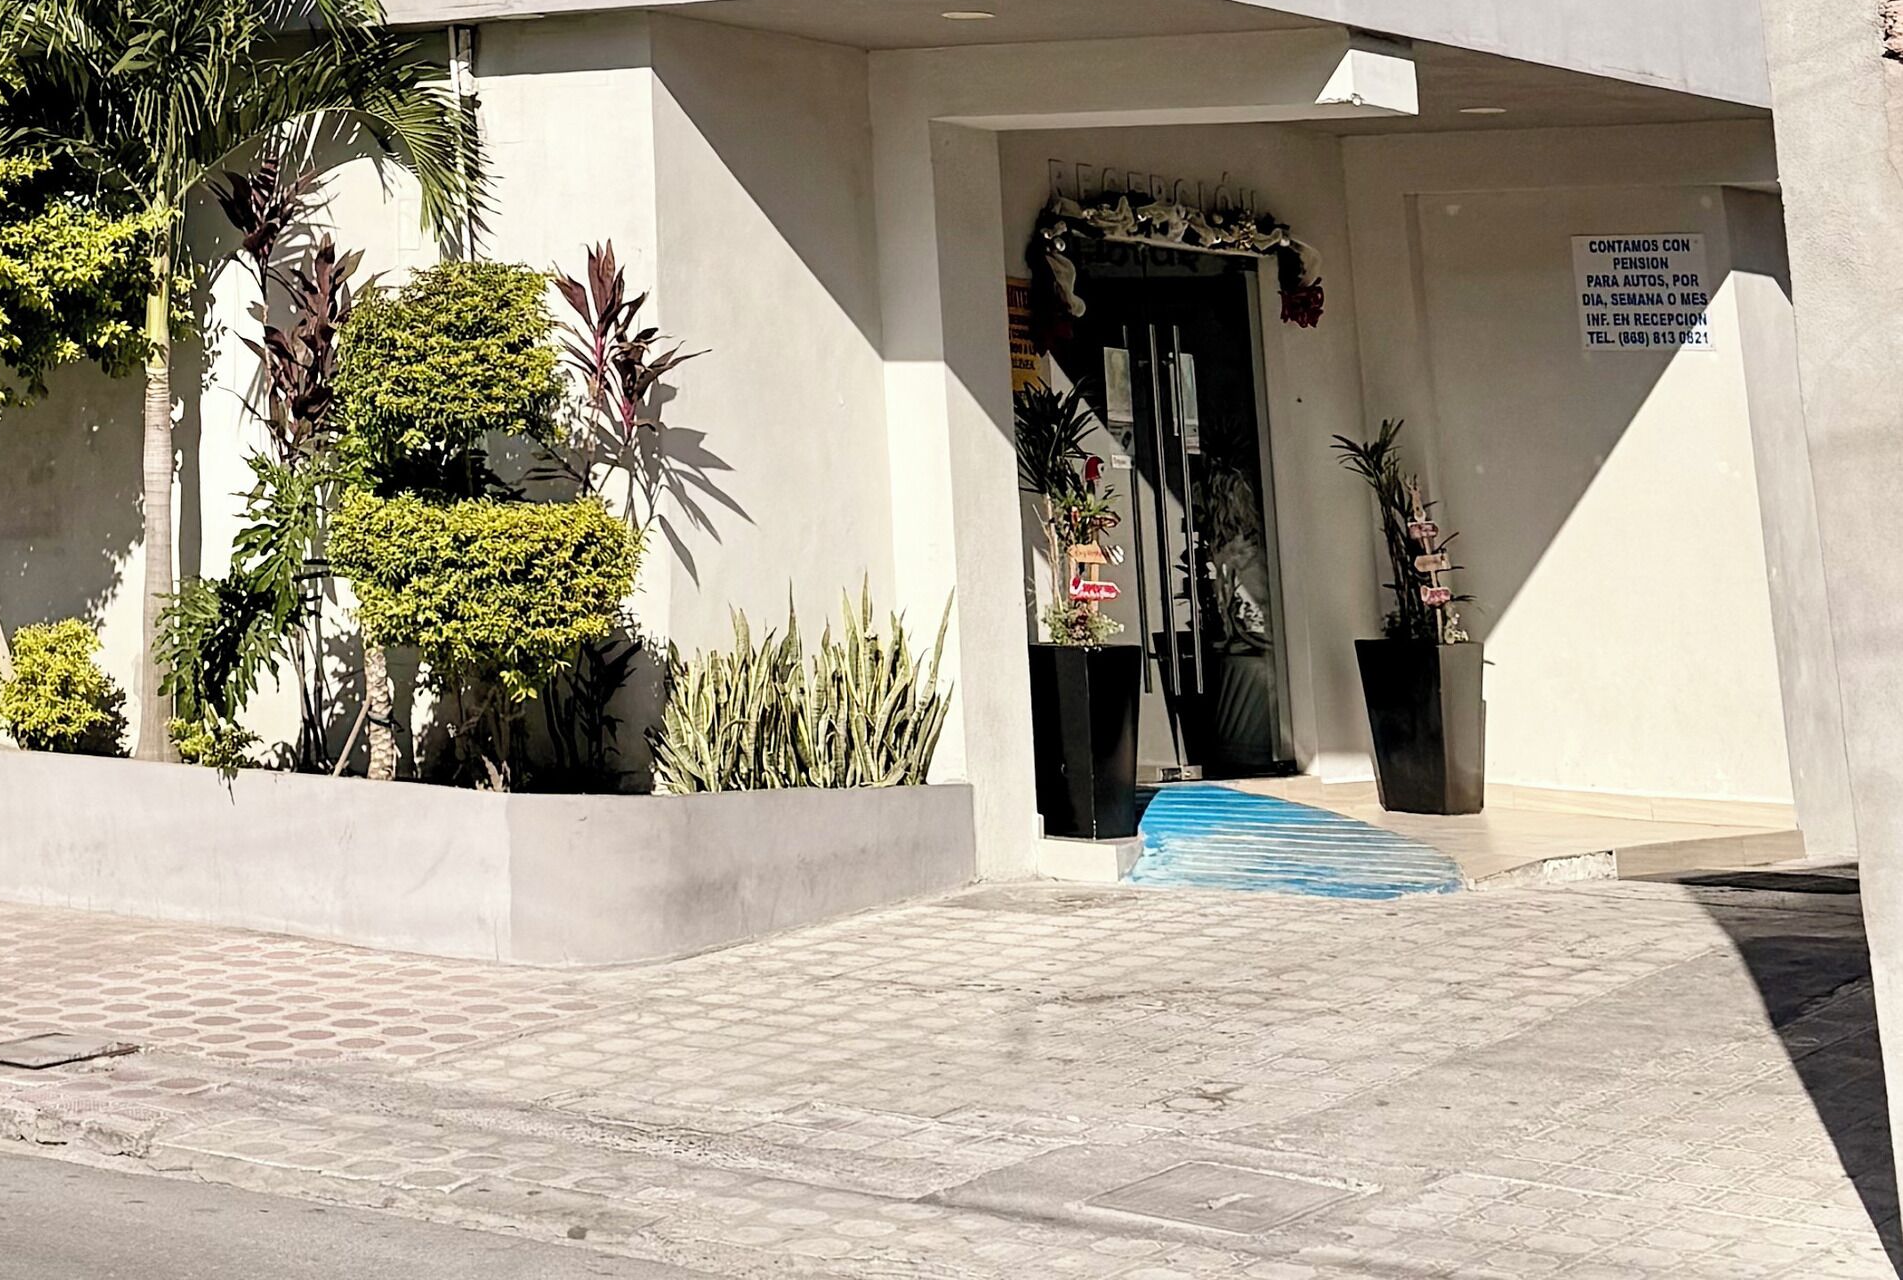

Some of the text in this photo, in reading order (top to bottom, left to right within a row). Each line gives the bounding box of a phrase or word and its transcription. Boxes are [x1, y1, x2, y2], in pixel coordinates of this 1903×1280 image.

[1589, 239, 1691, 253] CONTAMOS CON
[1613, 257, 1669, 270] PENSION
[1587, 274, 1699, 289] PARA AUTOS, POR
[1582, 293, 1708, 308] DIA, SEMANA O MES
[1586, 313, 1707, 326] INF. EN RECEPCION
[1587, 331, 1615, 344] TEL.
[1652, 331, 1675, 344] 813
